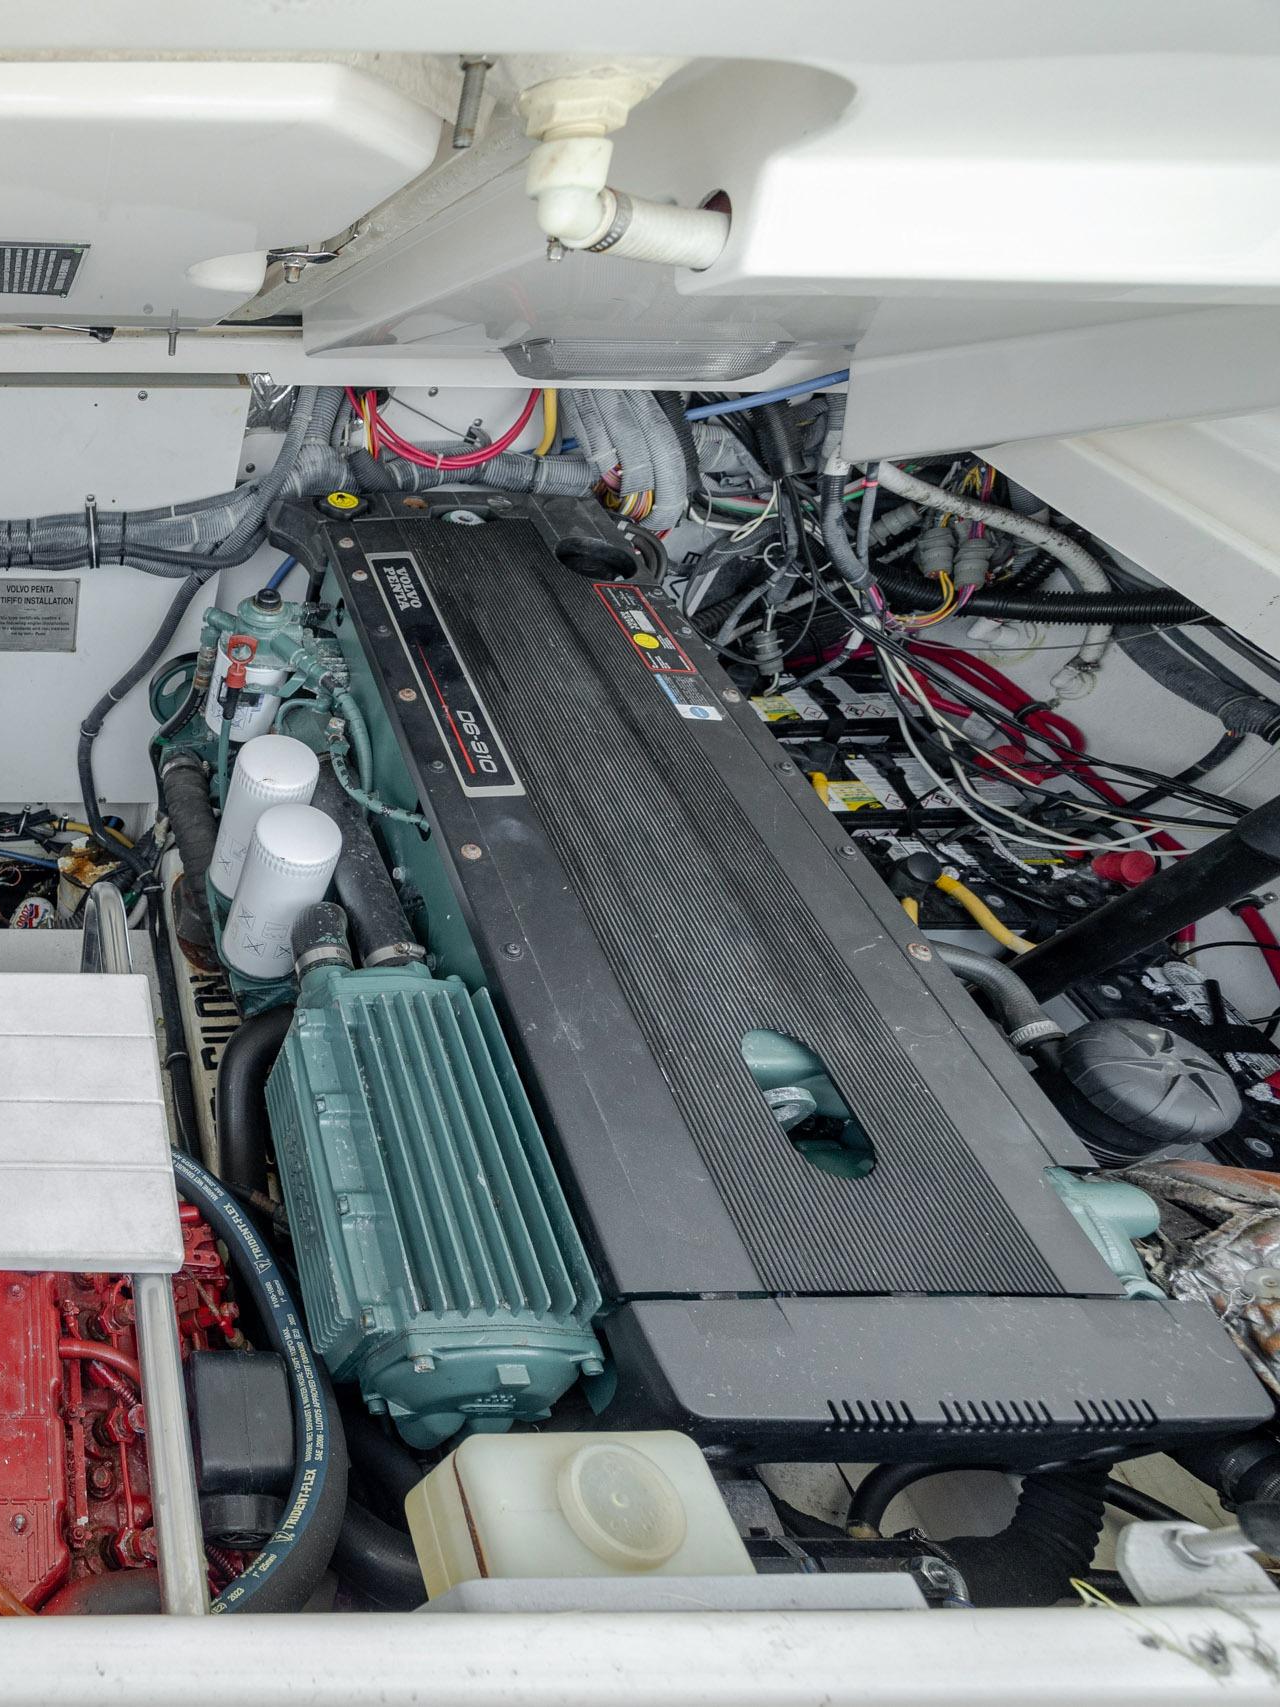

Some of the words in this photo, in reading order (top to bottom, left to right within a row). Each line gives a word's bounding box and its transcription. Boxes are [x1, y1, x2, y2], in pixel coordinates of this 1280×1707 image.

[6, 585, 30, 593] VOLVO
[31, 585, 54, 593] PENTA
[24, 597, 74, 605] INSTALLATION
[383, 566, 410, 611] PENTA
[396, 566, 422, 608] VOLVO
[456, 710, 498, 773] D6-310
[16, 904, 30, 928] 2000
[223, 1203, 264, 1260] TRIDENT-FLEX
[296, 1372, 305, 1387] HOSE
[303, 1364, 313, 1379] CERT
[308, 1379, 320, 1409] APPROVED
[282, 1469, 317, 1530] TRIDENT-FLEX
